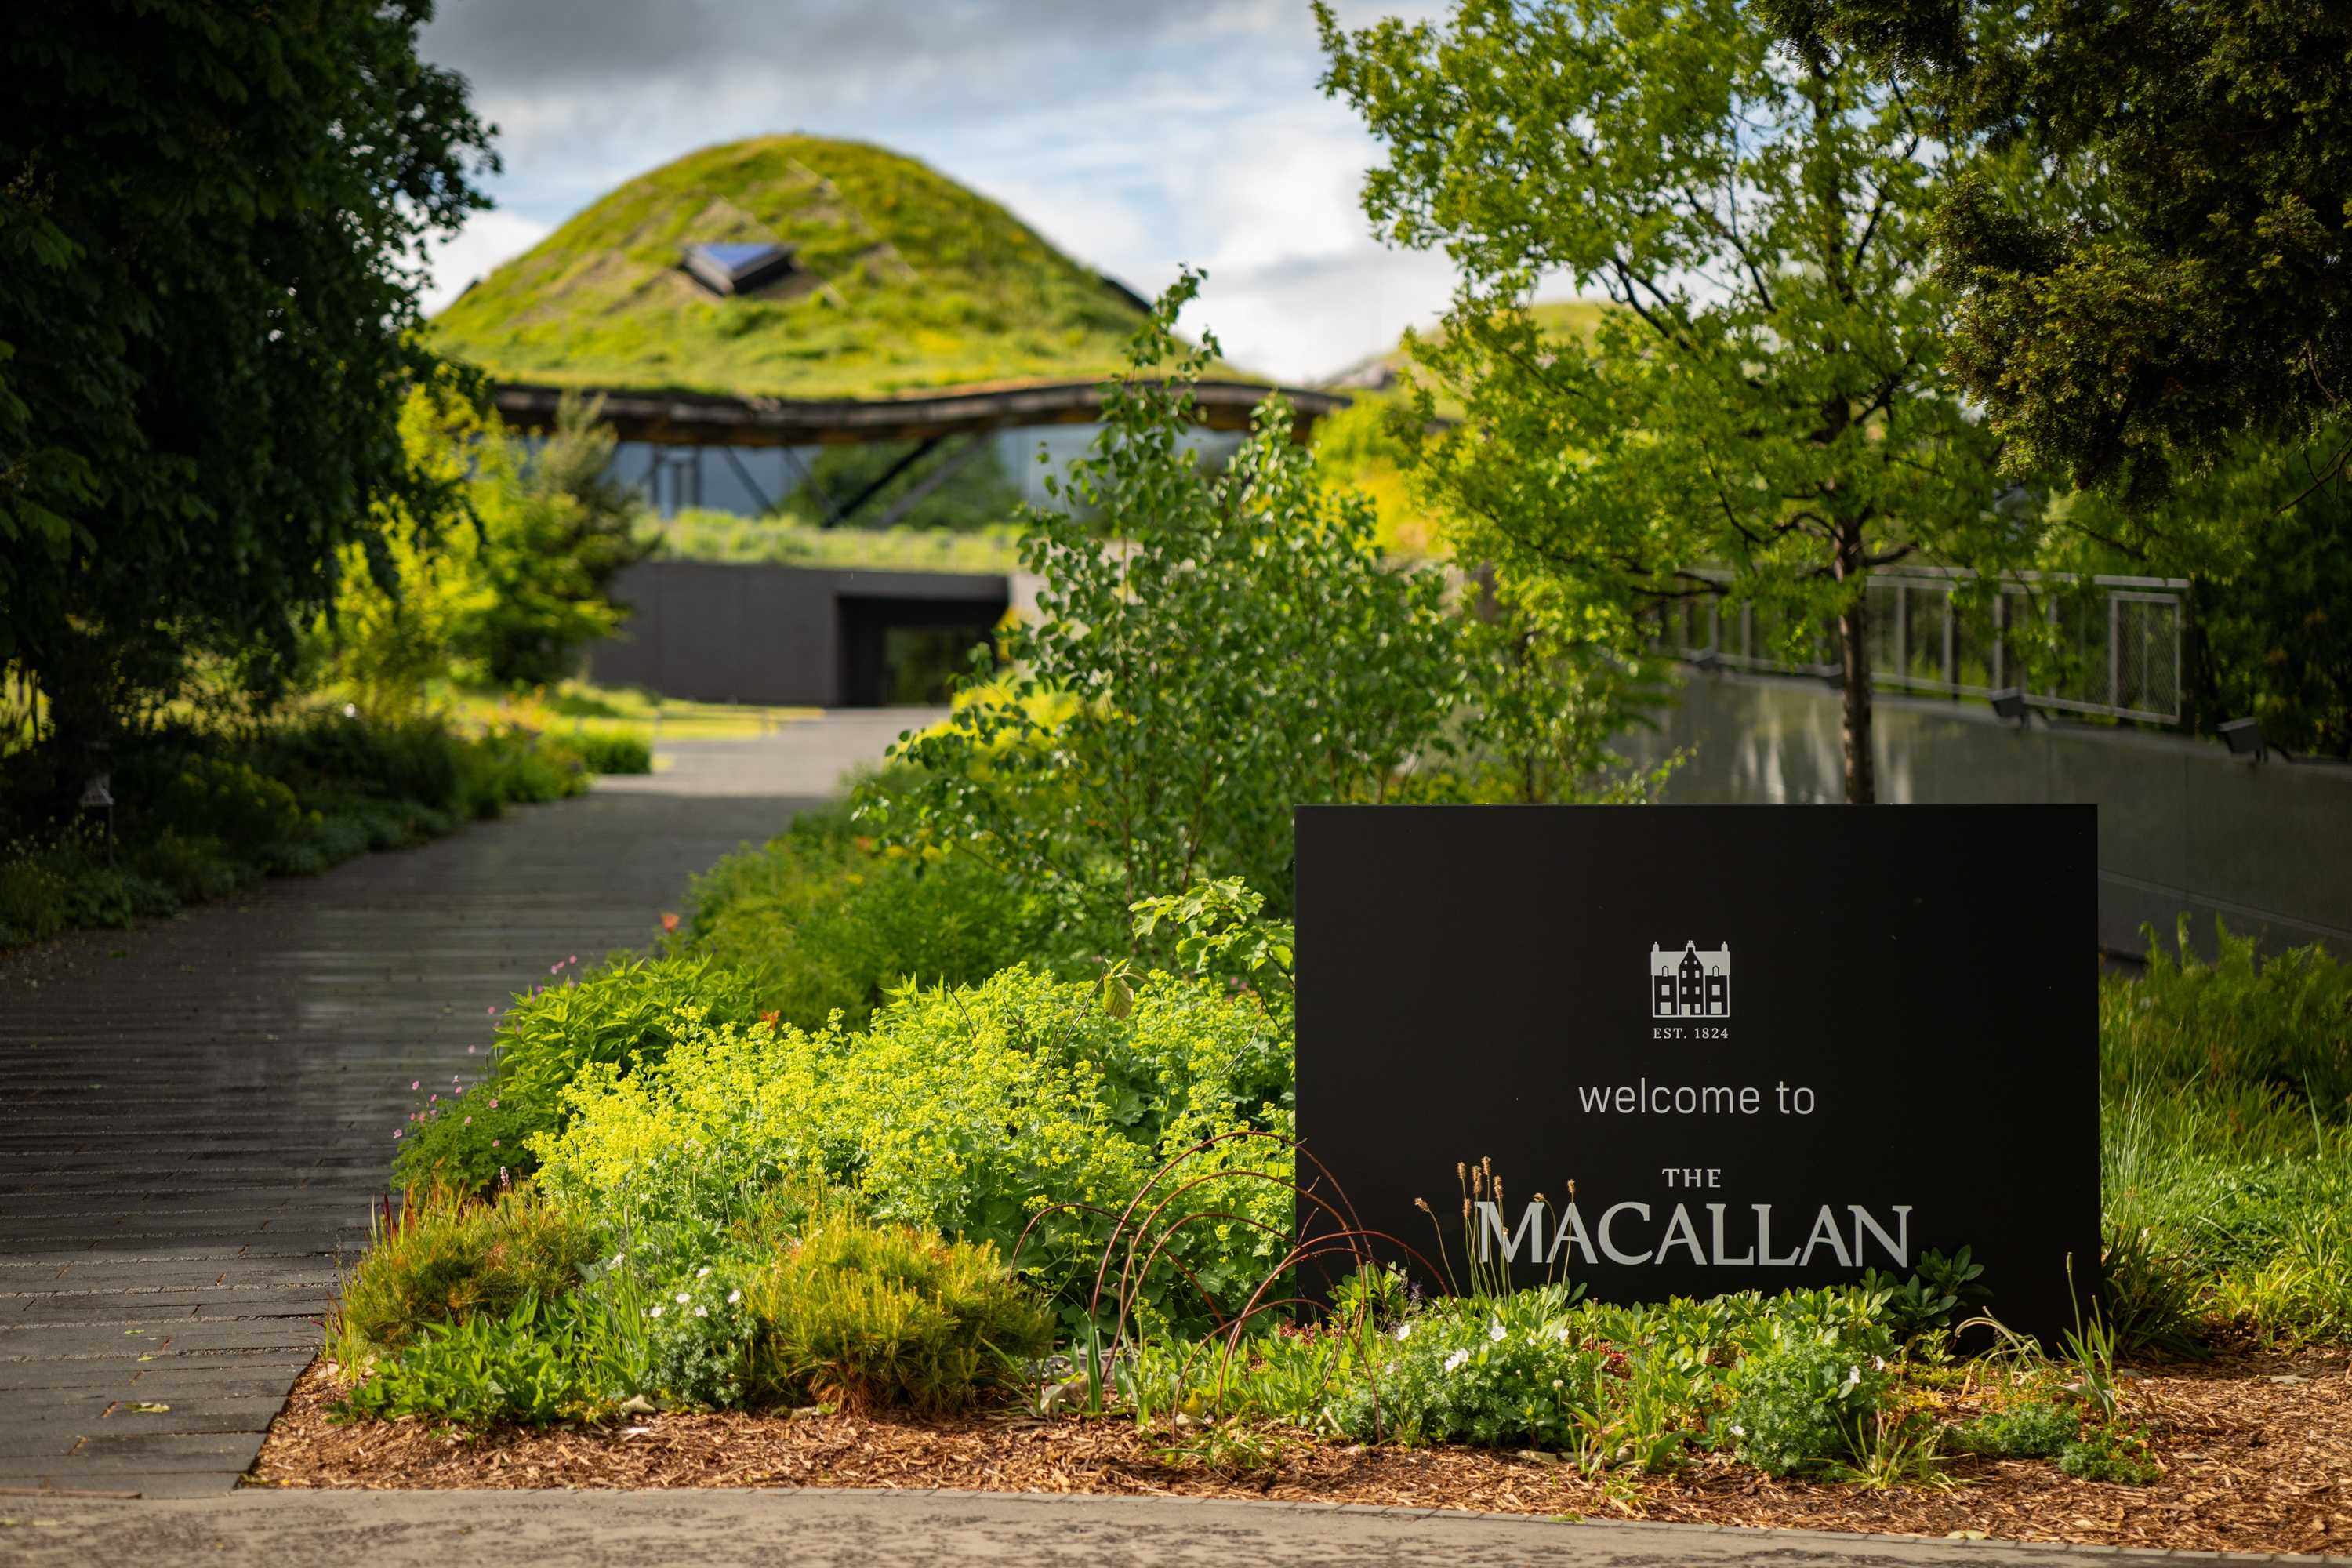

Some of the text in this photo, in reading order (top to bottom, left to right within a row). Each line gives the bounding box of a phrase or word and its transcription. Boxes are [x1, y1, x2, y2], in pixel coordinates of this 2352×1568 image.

[1653, 1027, 1730, 1040] EST. 1824
[1578, 1077, 1816, 1115] welcome to
[1662, 1168, 1722, 1189] THE
[1474, 1200, 1913, 1268] MACALLAN
